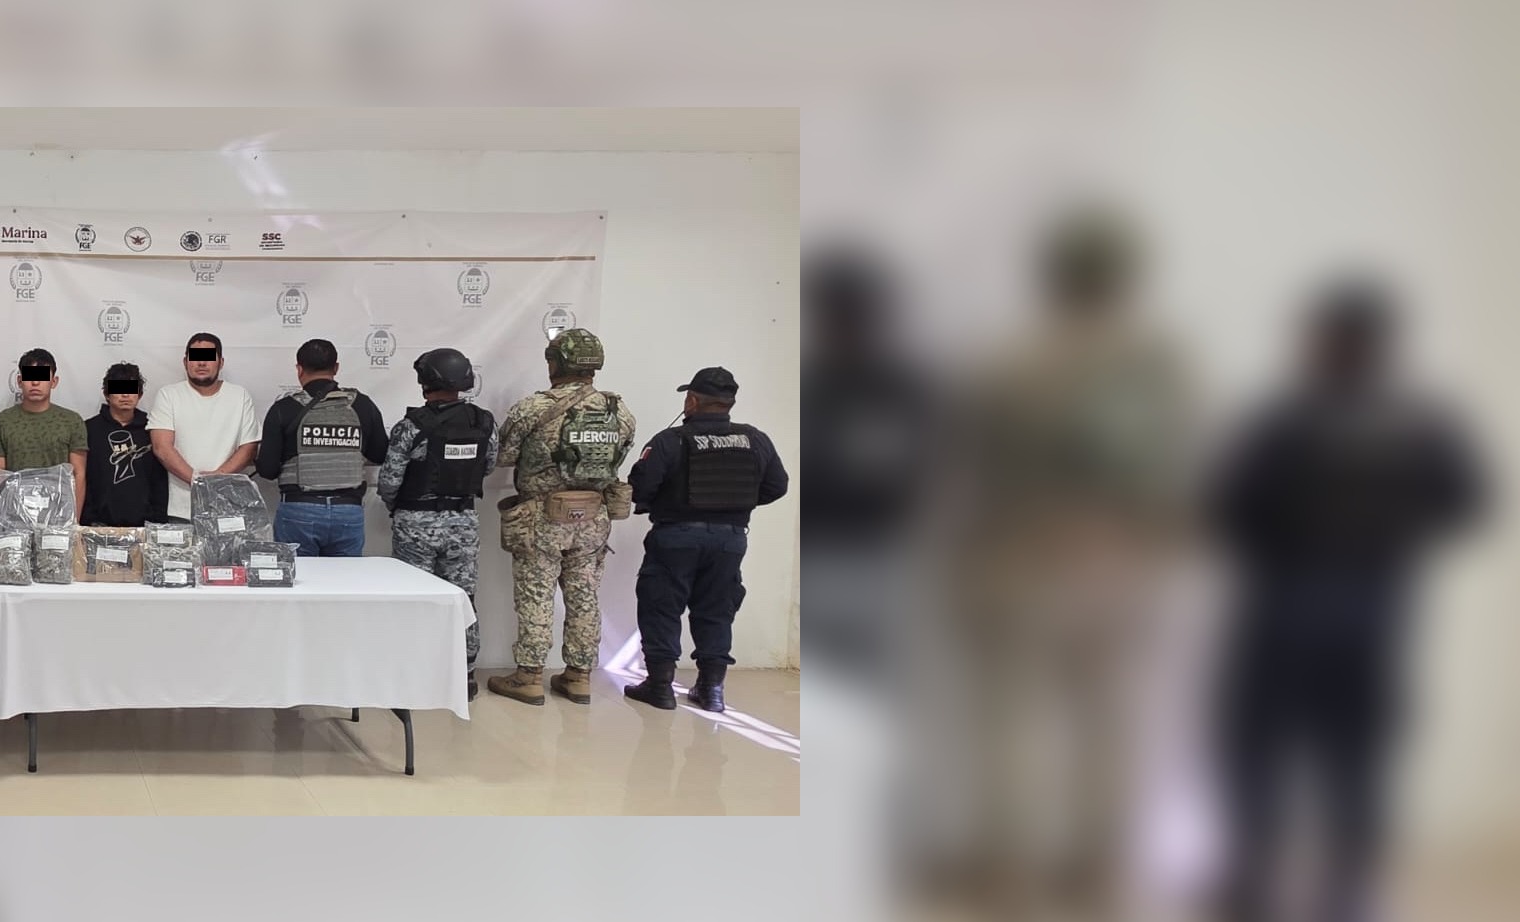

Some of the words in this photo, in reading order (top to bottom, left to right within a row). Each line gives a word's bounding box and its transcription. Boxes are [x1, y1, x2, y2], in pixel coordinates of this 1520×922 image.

[1, 227, 47, 239] Marina
[261, 232, 281, 240] SSC
[208, 234, 227, 244] FGR
[194, 271, 216, 283] FGE
[15, 288, 36, 300] FGE
[461, 294, 483, 305] FGE
[281, 314, 303, 325] FGE
[103, 332, 124, 343] FGE
[369, 354, 390, 366] FGE
[303, 425, 361, 437] POLICÍA
[303, 437, 312, 445] DE
[313, 437, 360, 447] INVESTIGACIÓN
